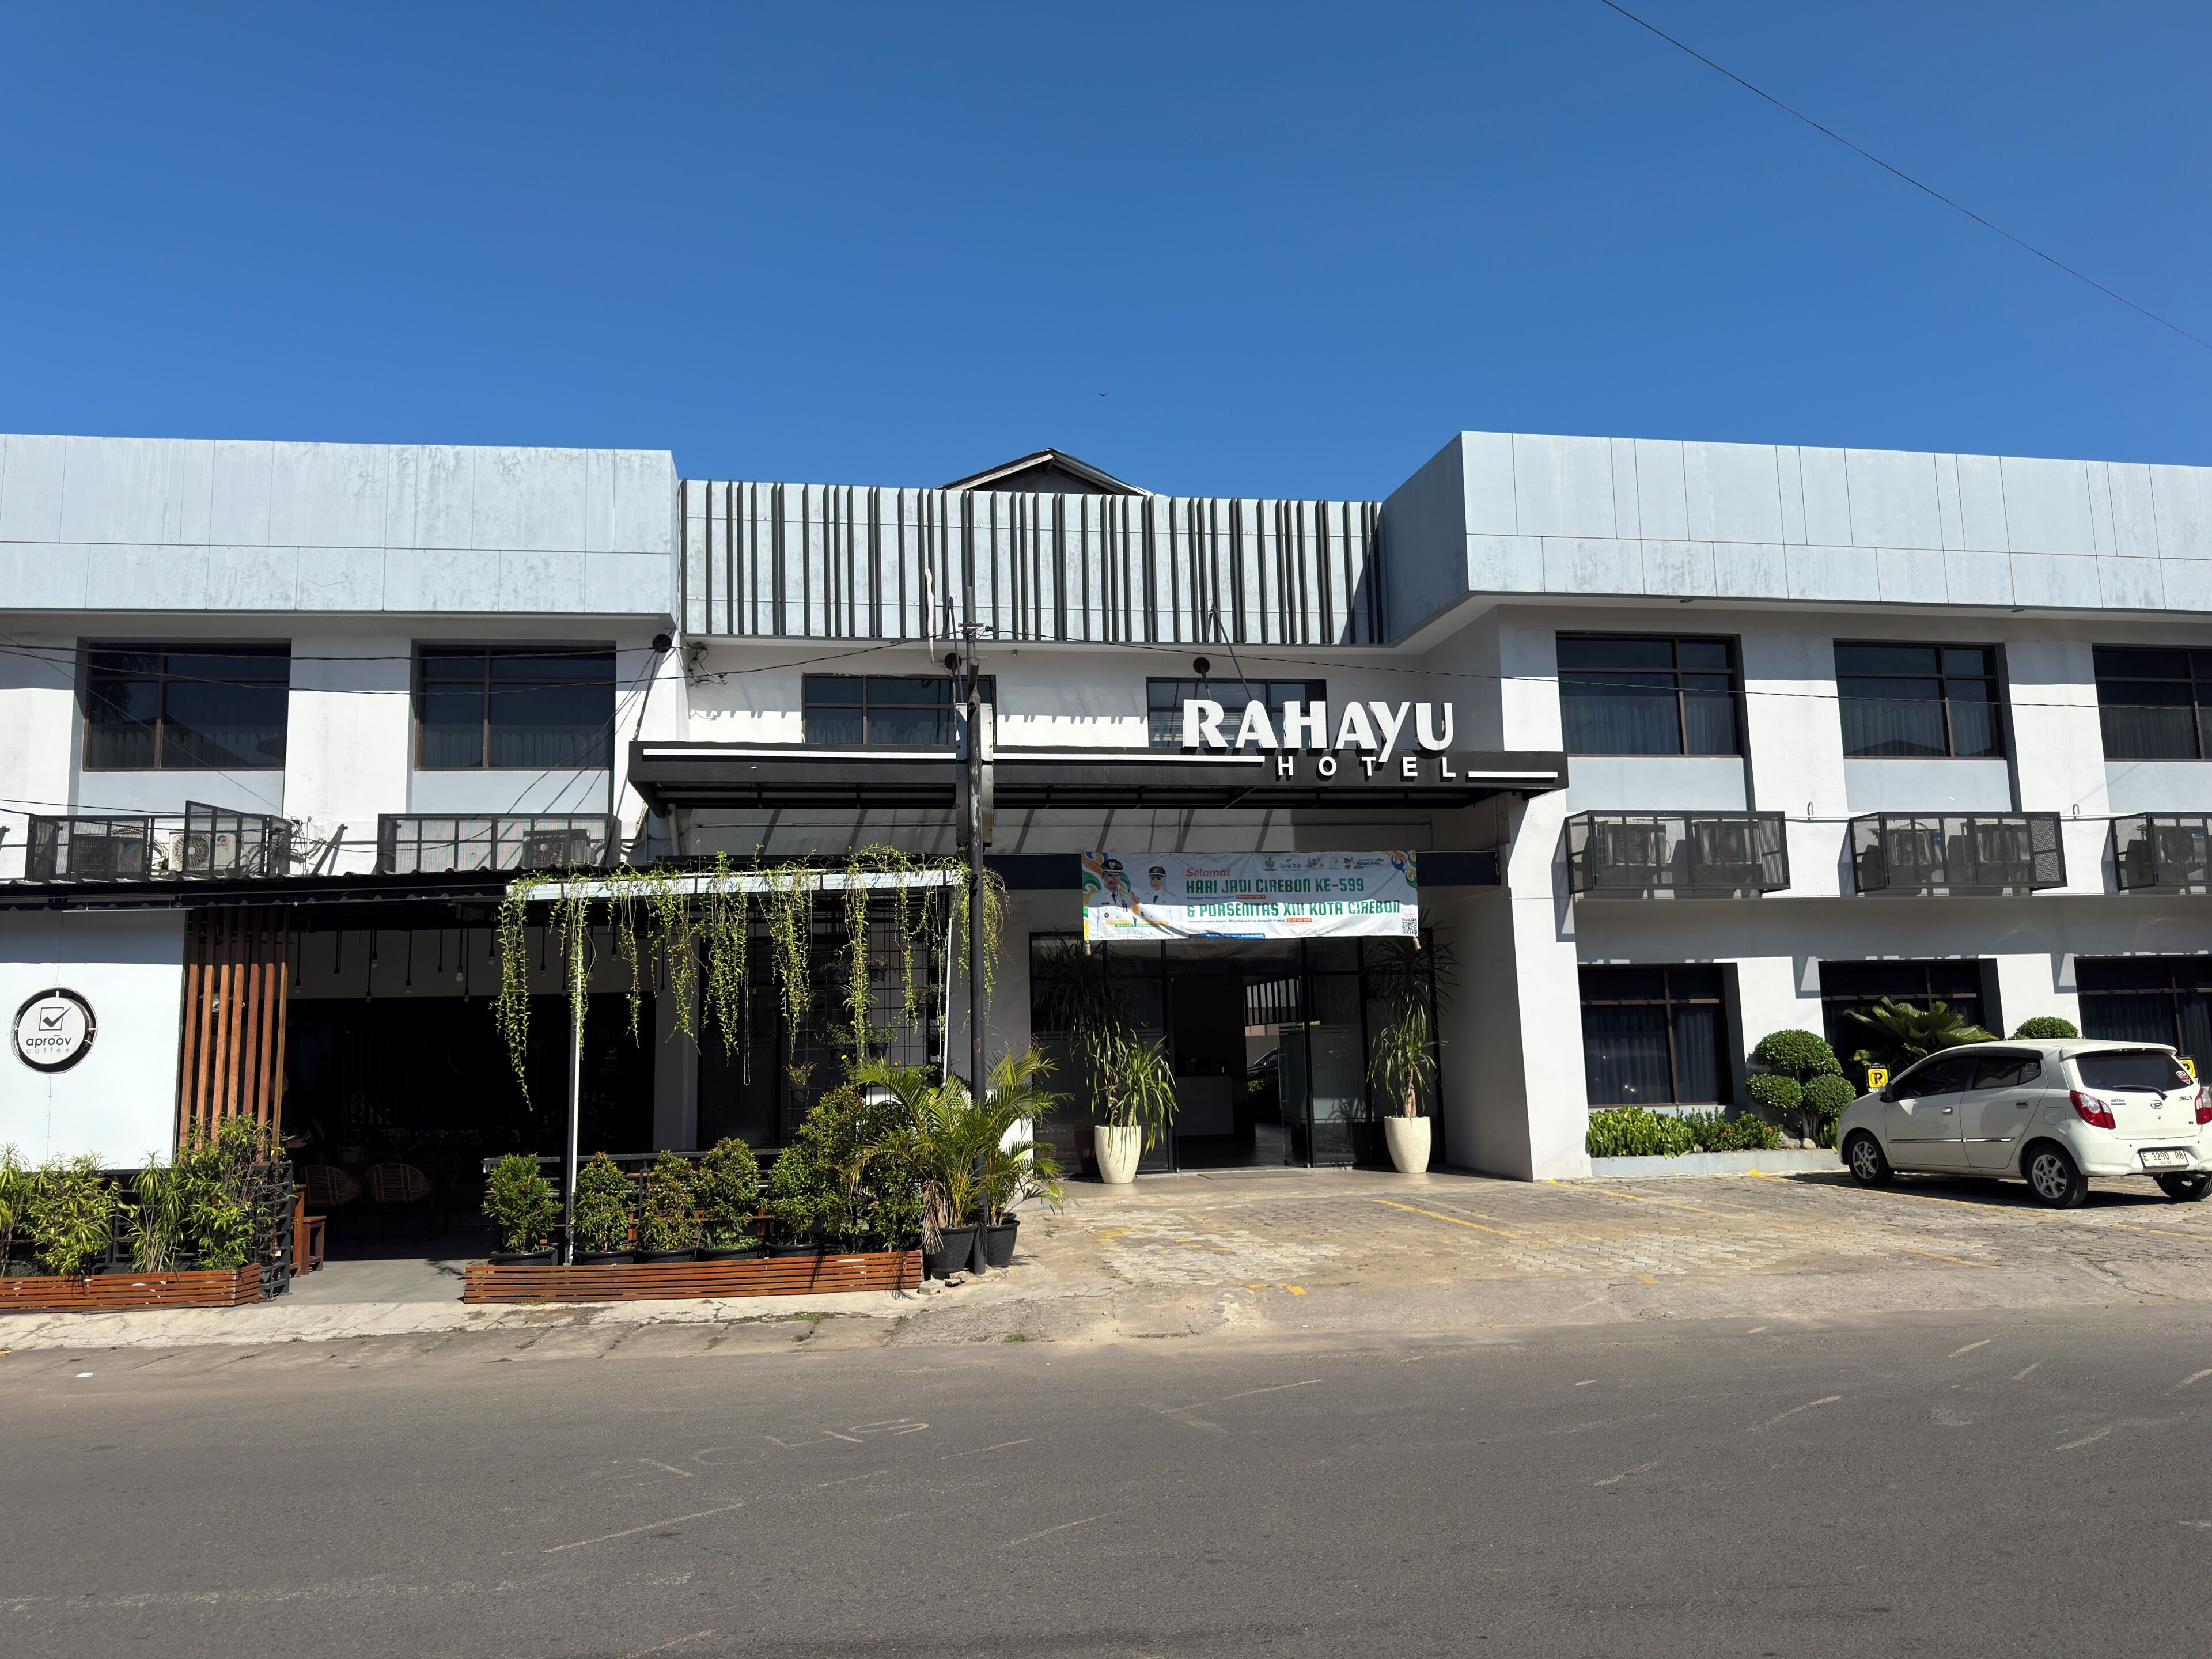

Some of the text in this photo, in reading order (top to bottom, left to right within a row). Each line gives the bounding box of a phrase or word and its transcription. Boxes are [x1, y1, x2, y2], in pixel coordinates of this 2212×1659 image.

[1183, 699, 1454, 762] RAHAYU
[1278, 756, 1456, 777] HOTEL
[1186, 868, 1231, 877] Selamat
[1186, 878, 1365, 893] HARI JADI CIREBON KE-599
[1187, 904, 1195, 917] &
[1283, 903, 1305, 916] XIII
[1310, 902, 1343, 915] KOTA
[1348, 900, 1400, 914] CIREBON
[2142, 1151, 2185, 1161] E 1290 RB
